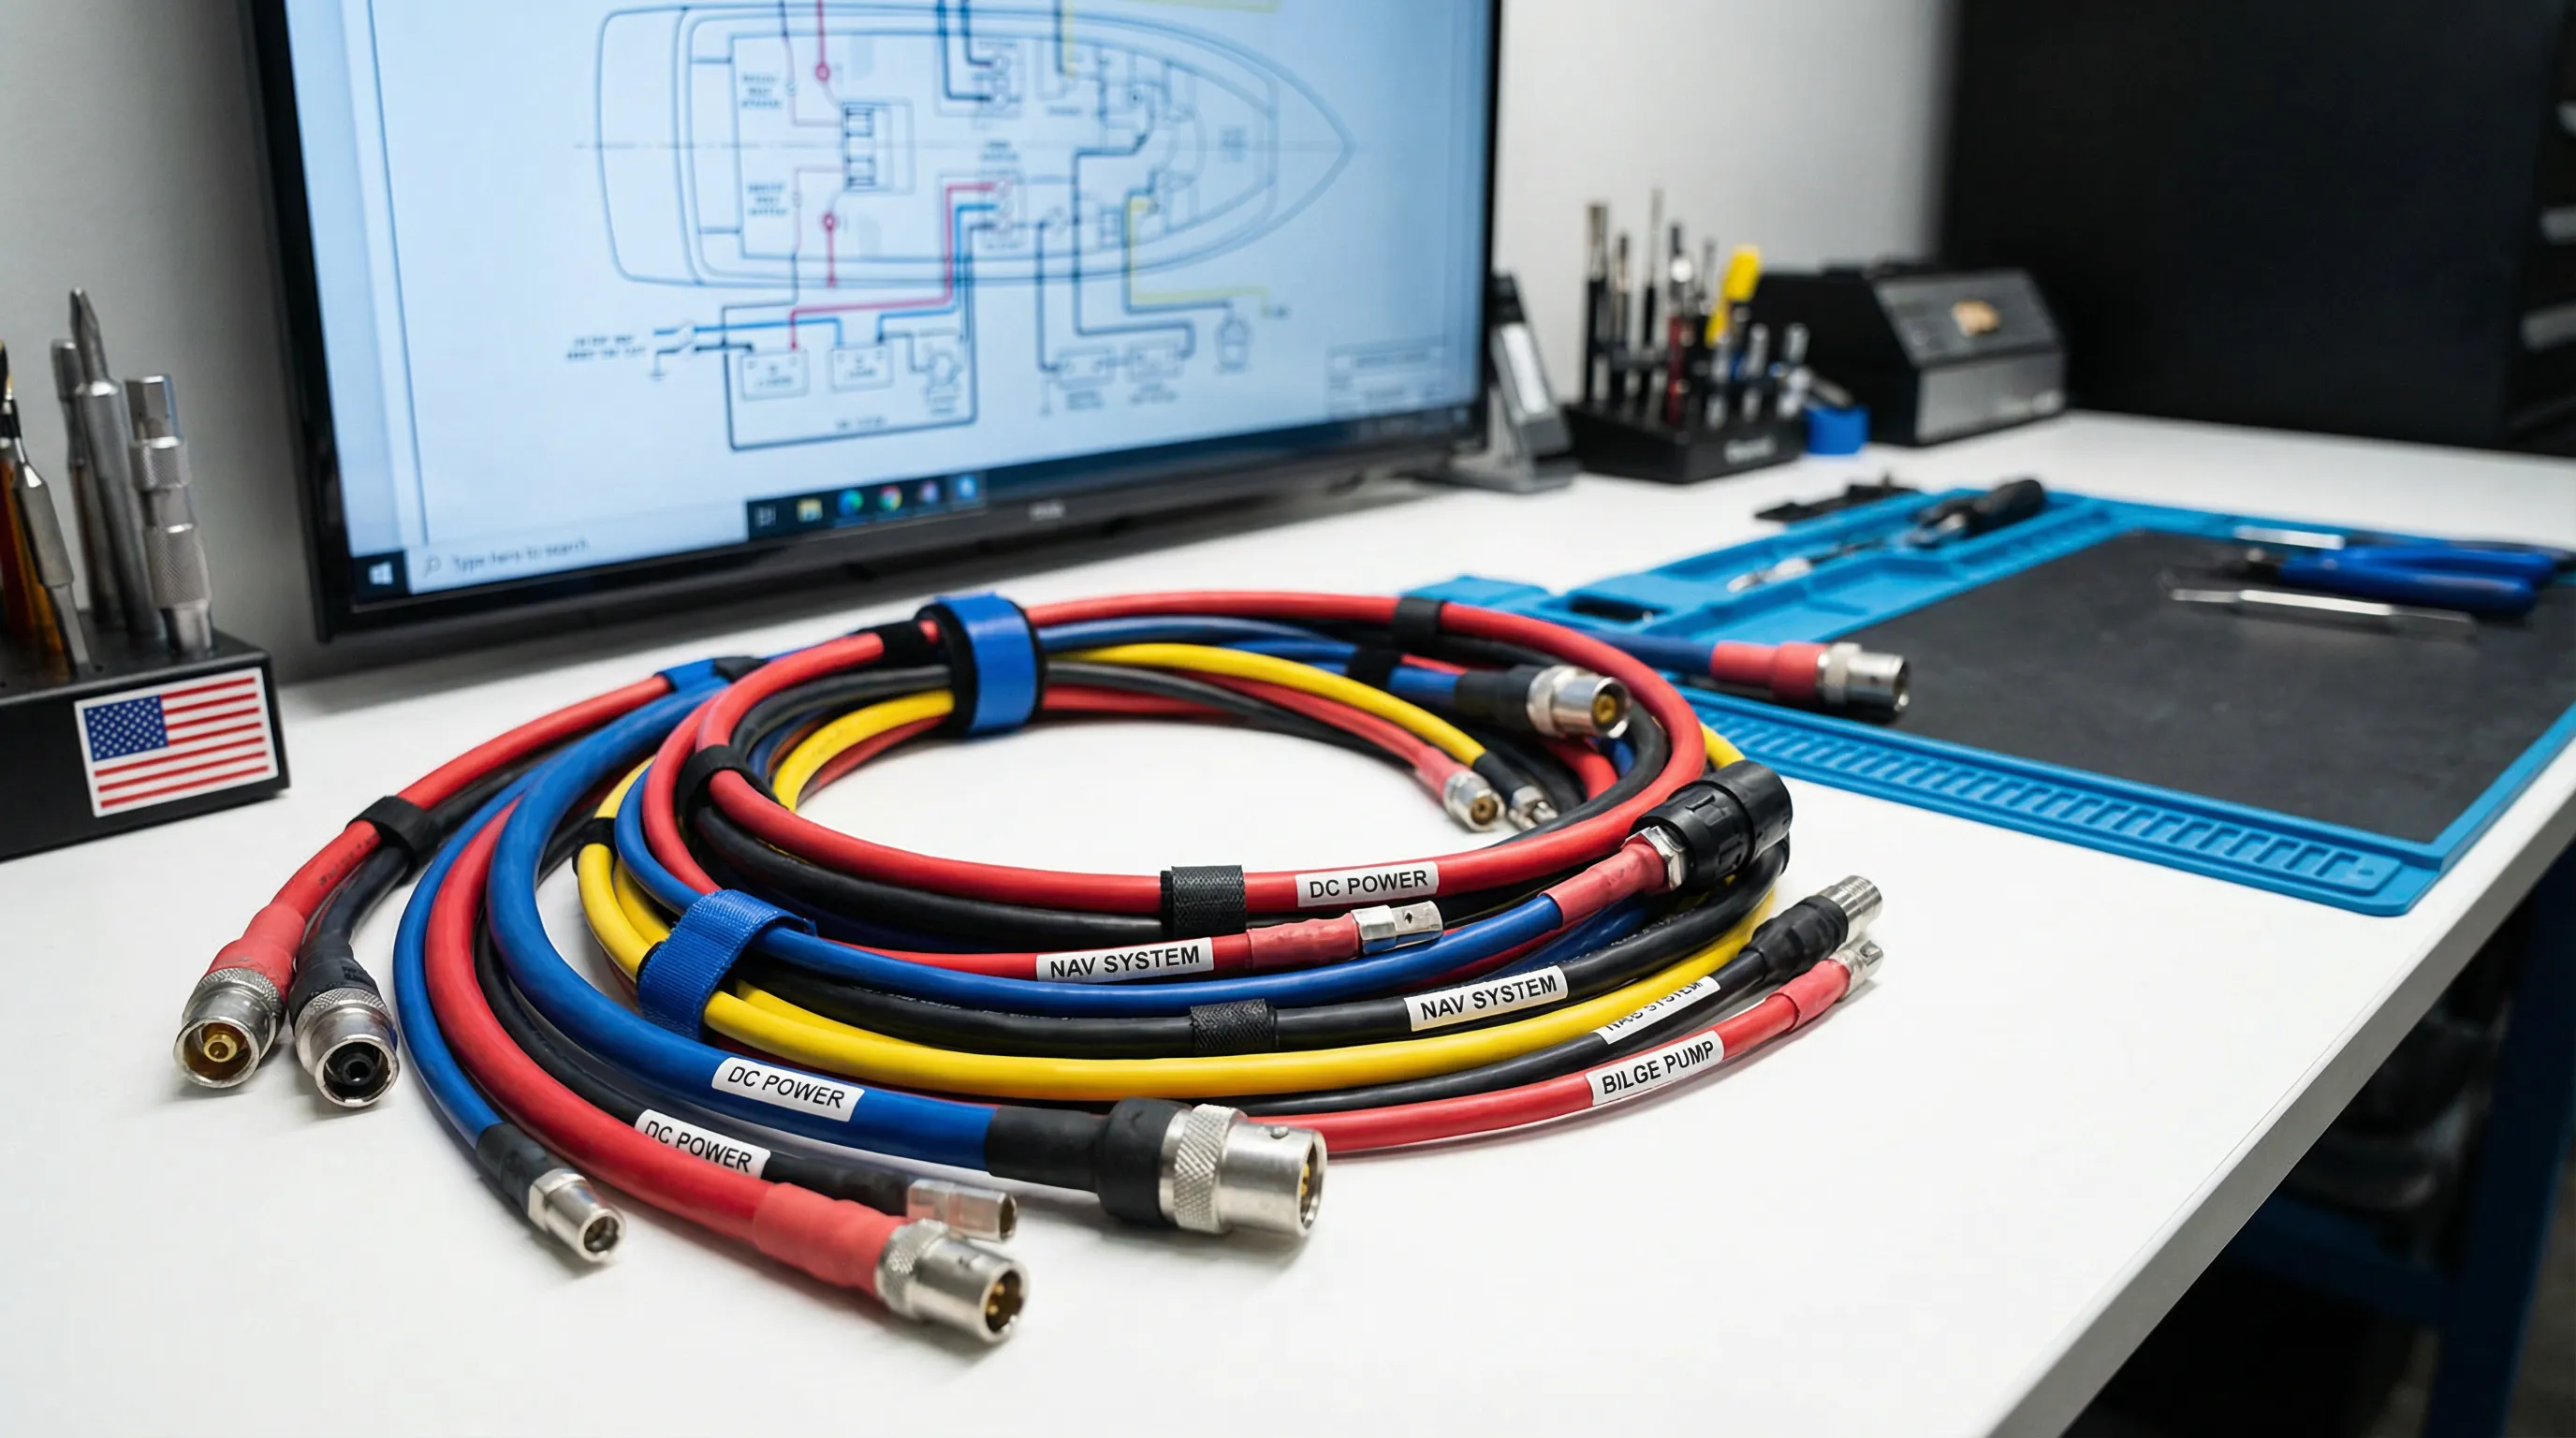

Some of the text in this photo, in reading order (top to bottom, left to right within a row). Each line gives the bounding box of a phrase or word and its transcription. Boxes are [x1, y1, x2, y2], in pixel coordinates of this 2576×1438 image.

[450, 553, 485, 572] Type
[1310, 870, 1428, 899] DC POWER
[1050, 946, 1200, 978] NAV SYSTEM
[1420, 975, 1558, 1020] NAV SYSTEM
[727, 1066, 845, 1108] DC POWER
[1602, 1040, 1714, 1094] BILGE PUMP
[644, 1121, 753, 1172] DC POWER
